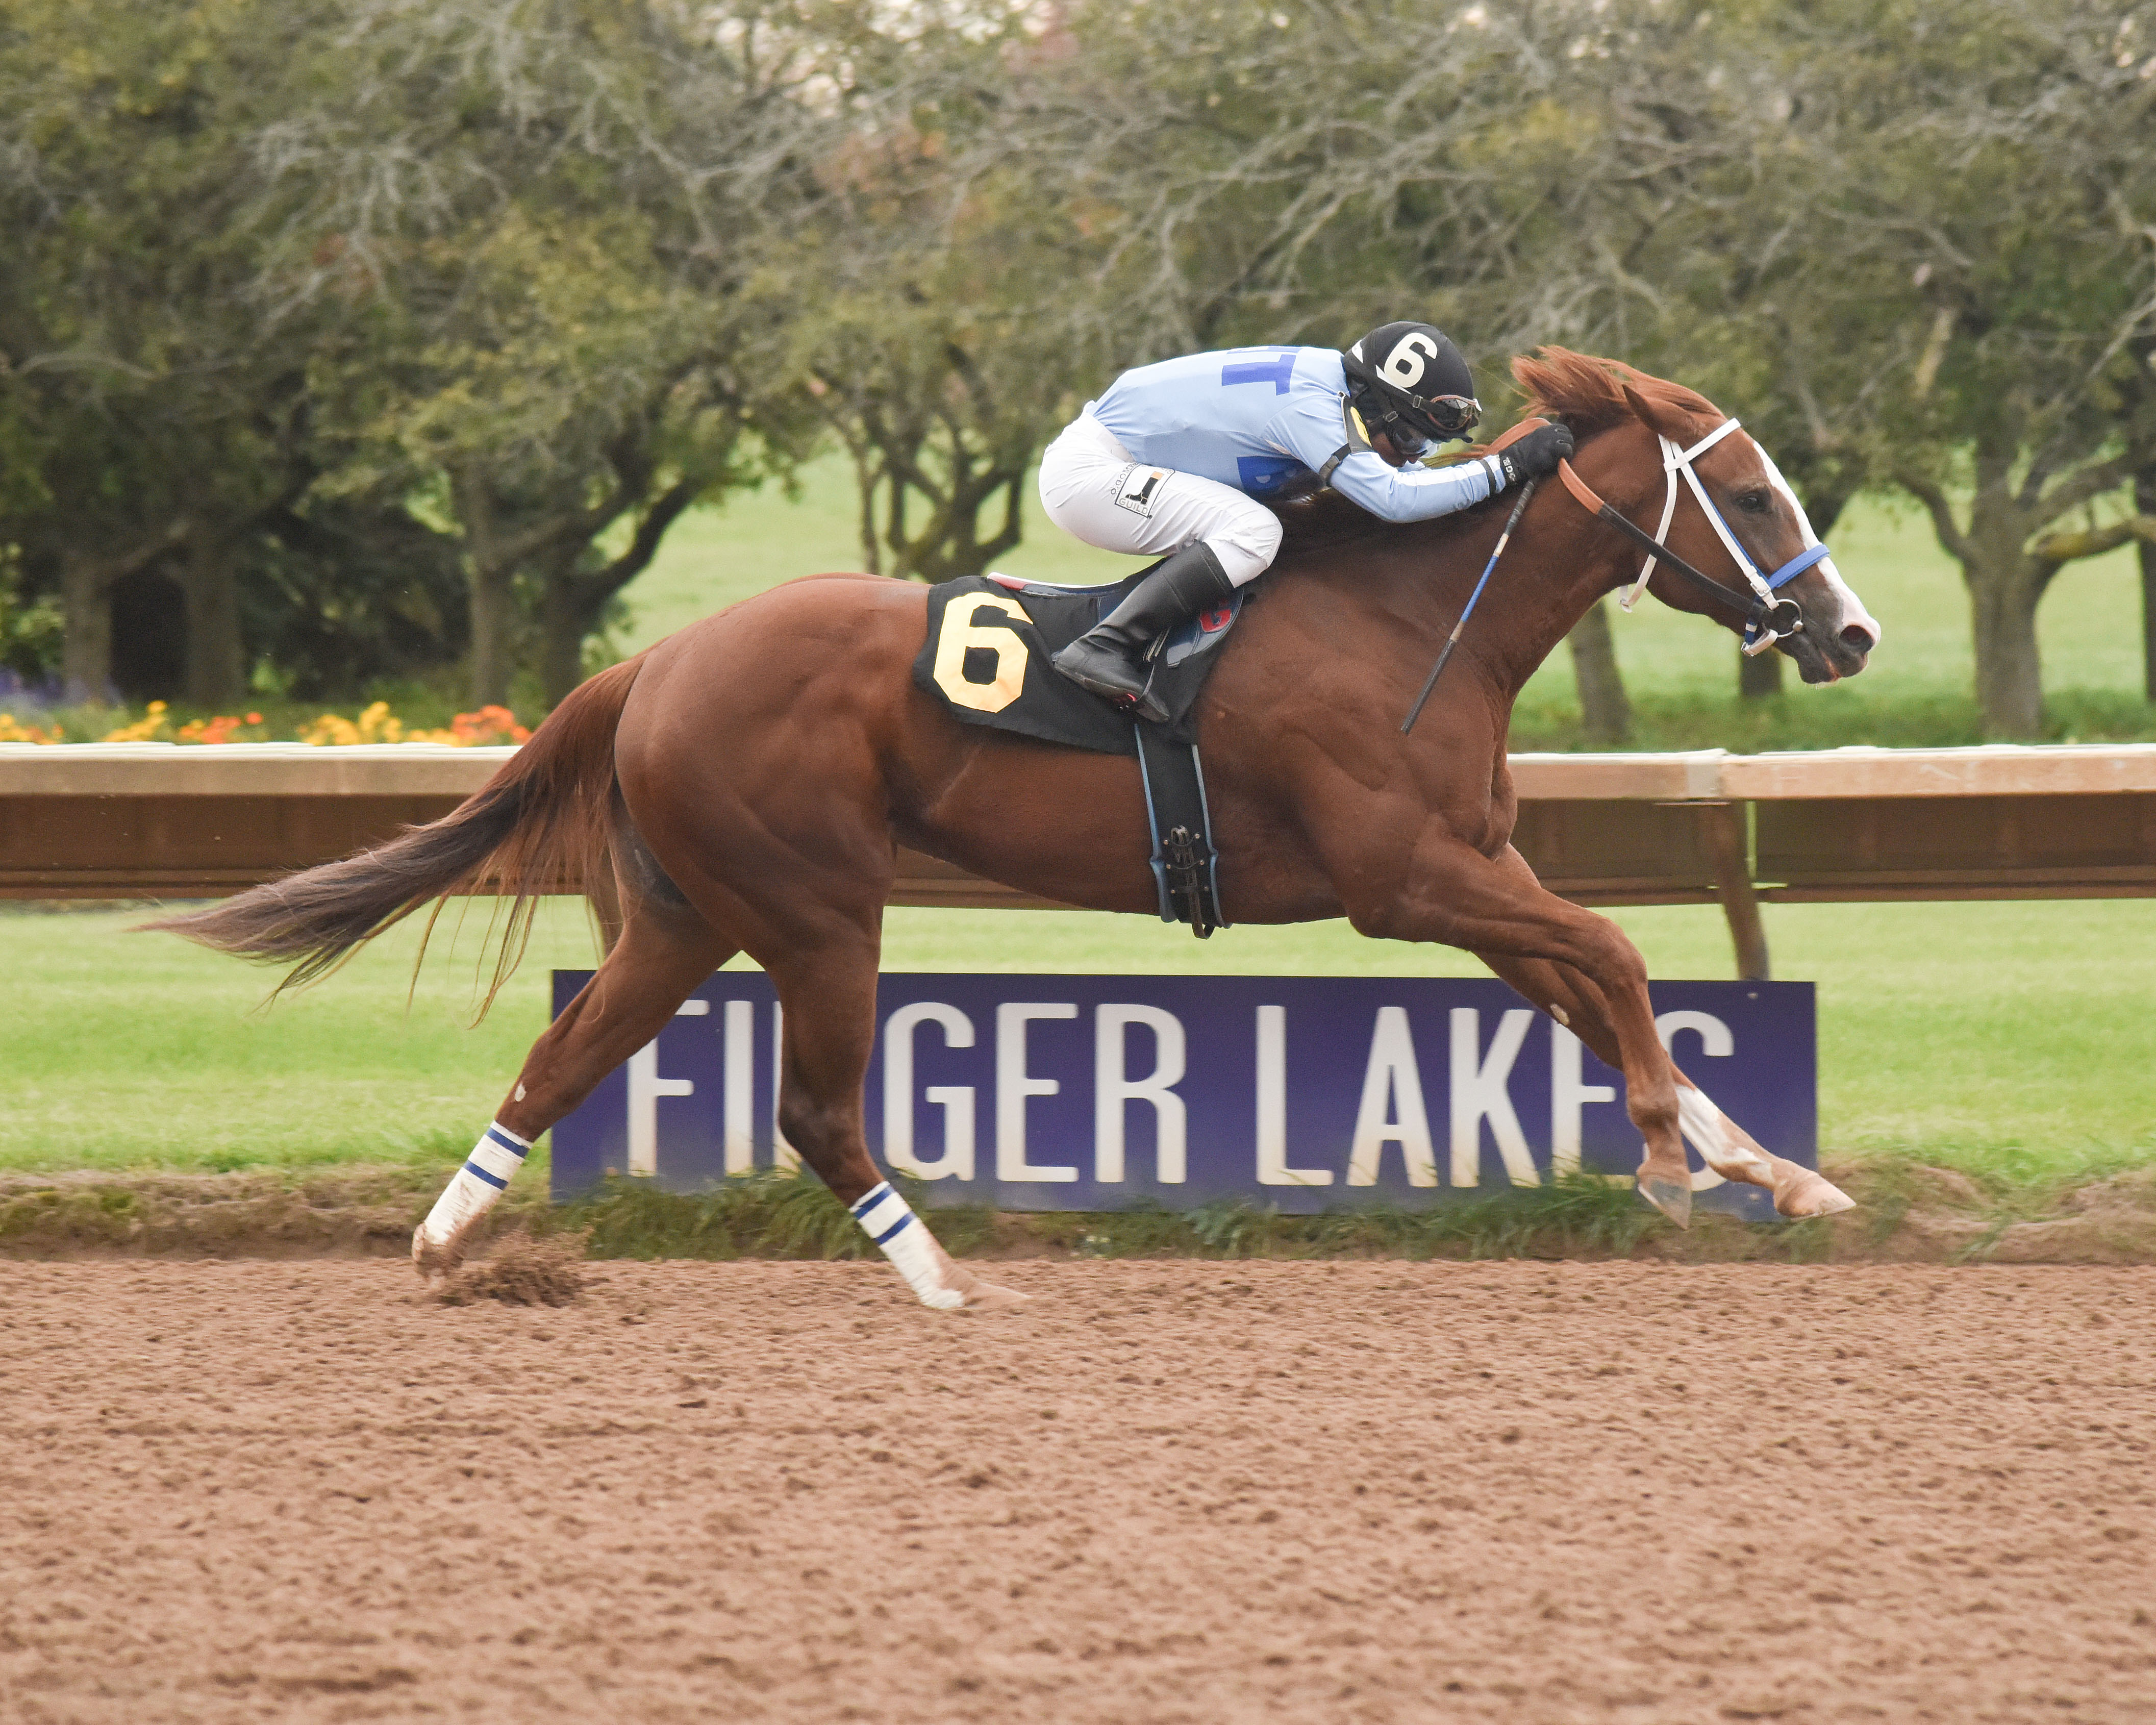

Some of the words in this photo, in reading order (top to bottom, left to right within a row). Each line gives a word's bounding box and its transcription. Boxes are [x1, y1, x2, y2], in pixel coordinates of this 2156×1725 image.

[1384, 333, 1438, 388] 6
[1119, 498, 1148, 514] GUILD
[933, 592, 1033, 713] 6
[627, 1000, 1187, 1183] FIGER
